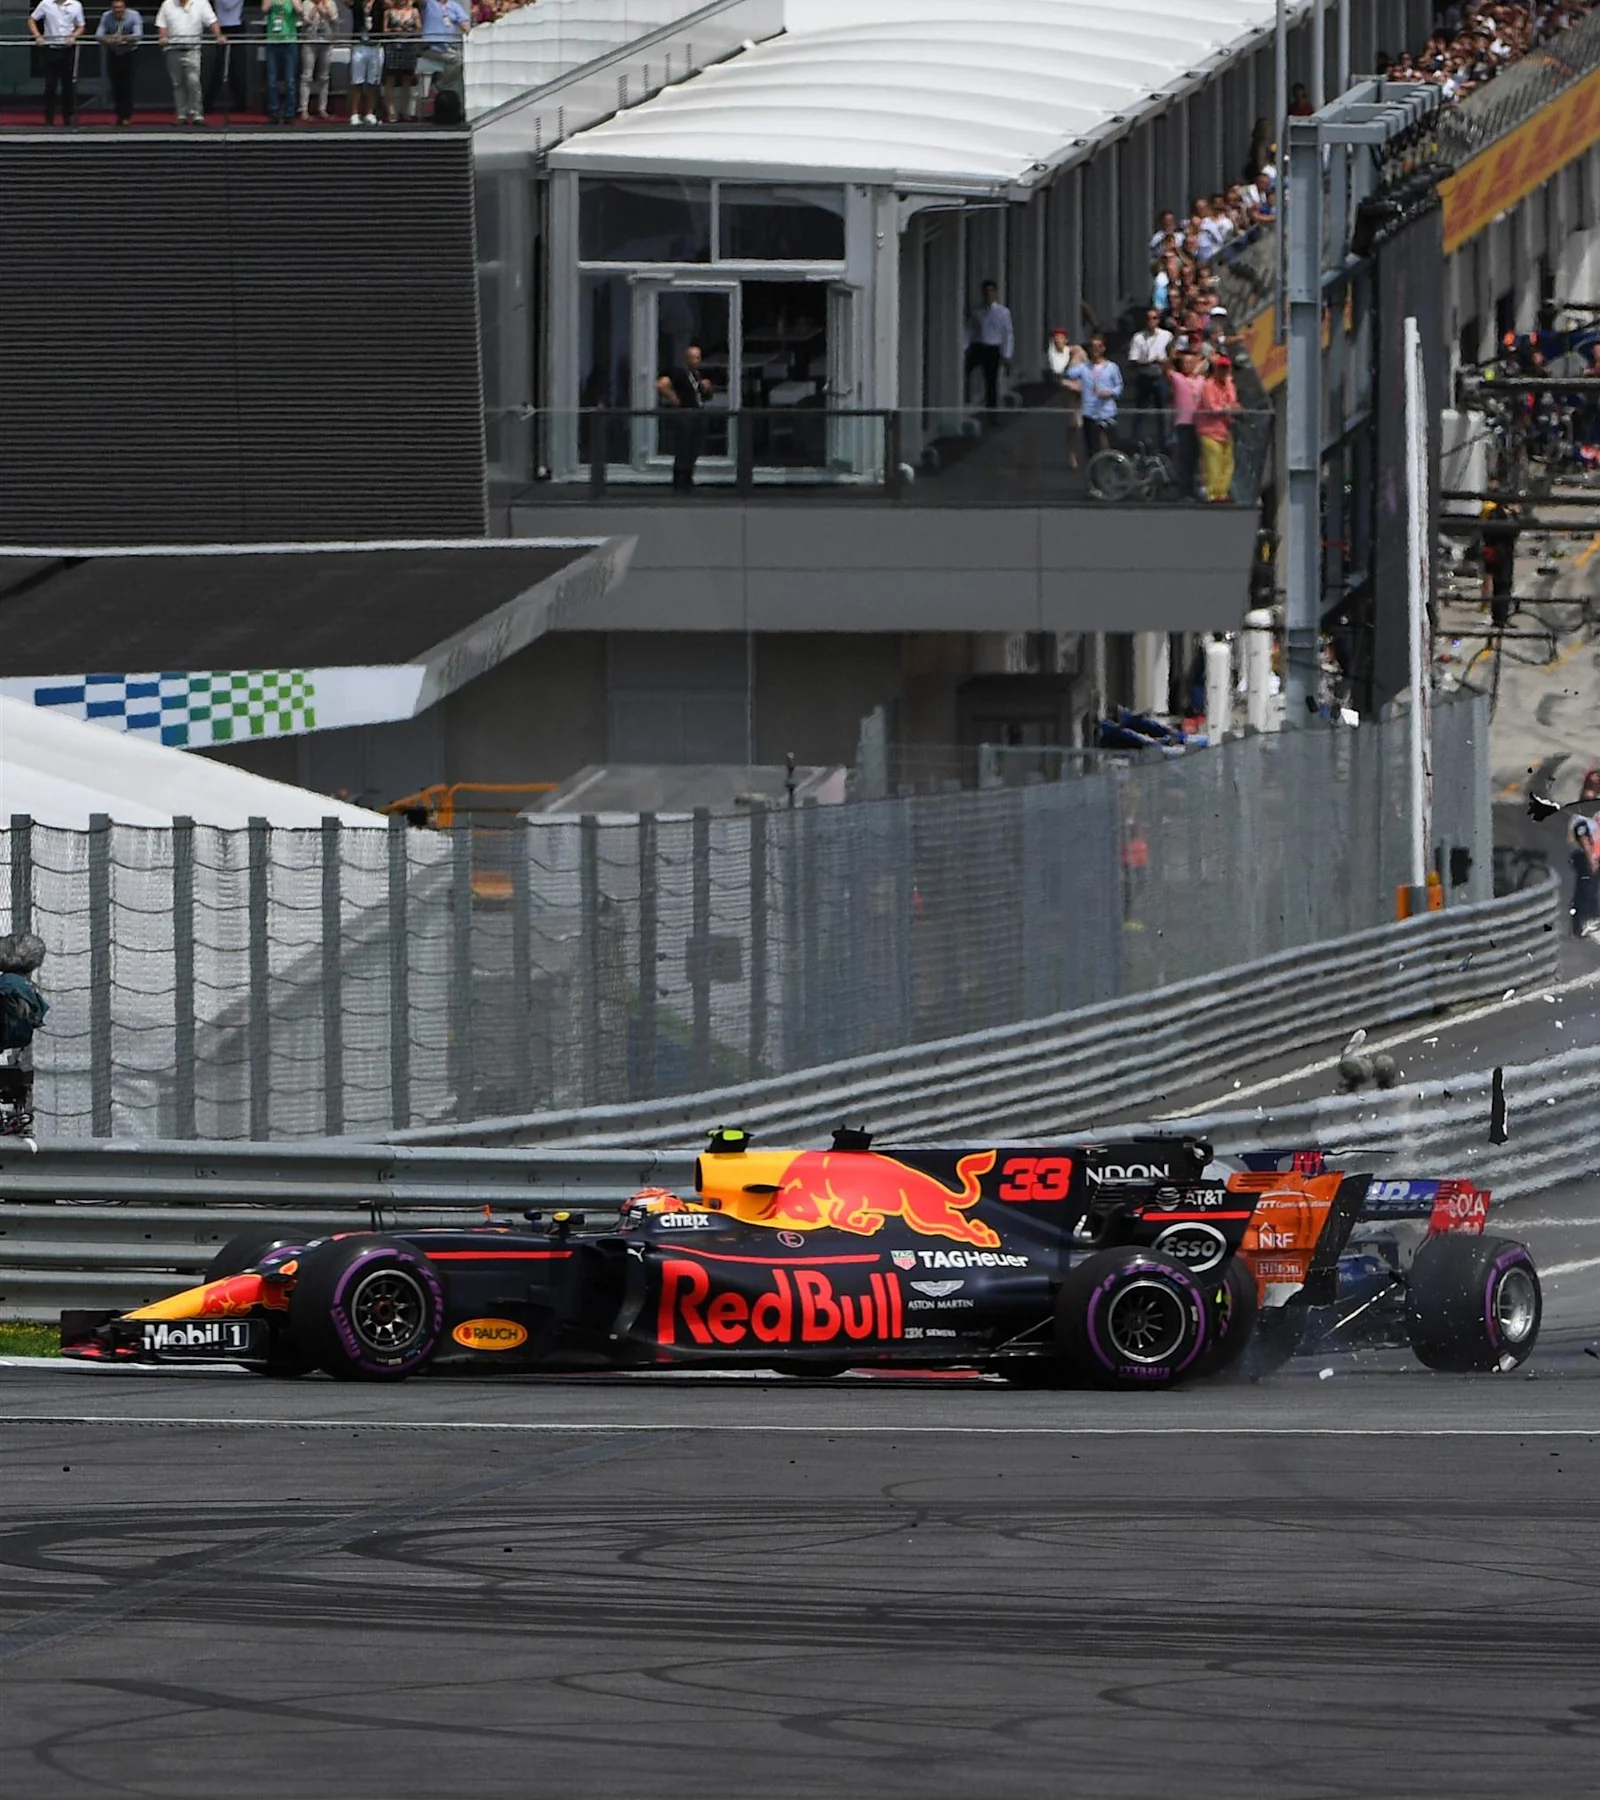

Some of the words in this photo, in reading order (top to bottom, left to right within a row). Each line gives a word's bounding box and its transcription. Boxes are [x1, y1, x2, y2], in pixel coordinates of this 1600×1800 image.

[999, 1158, 1072, 1201] 33
[1184, 1189, 1226, 1206] AT&T
[1258, 1262, 1300, 1275] Hilton
[907, 1299, 936, 1310] ASTON
[936, 1298, 974, 1309] MARTIN
[141, 1323, 220, 1351] Mobil
[230, 1325, 241, 1346] 1
[473, 1326, 518, 1341] RAUCH
